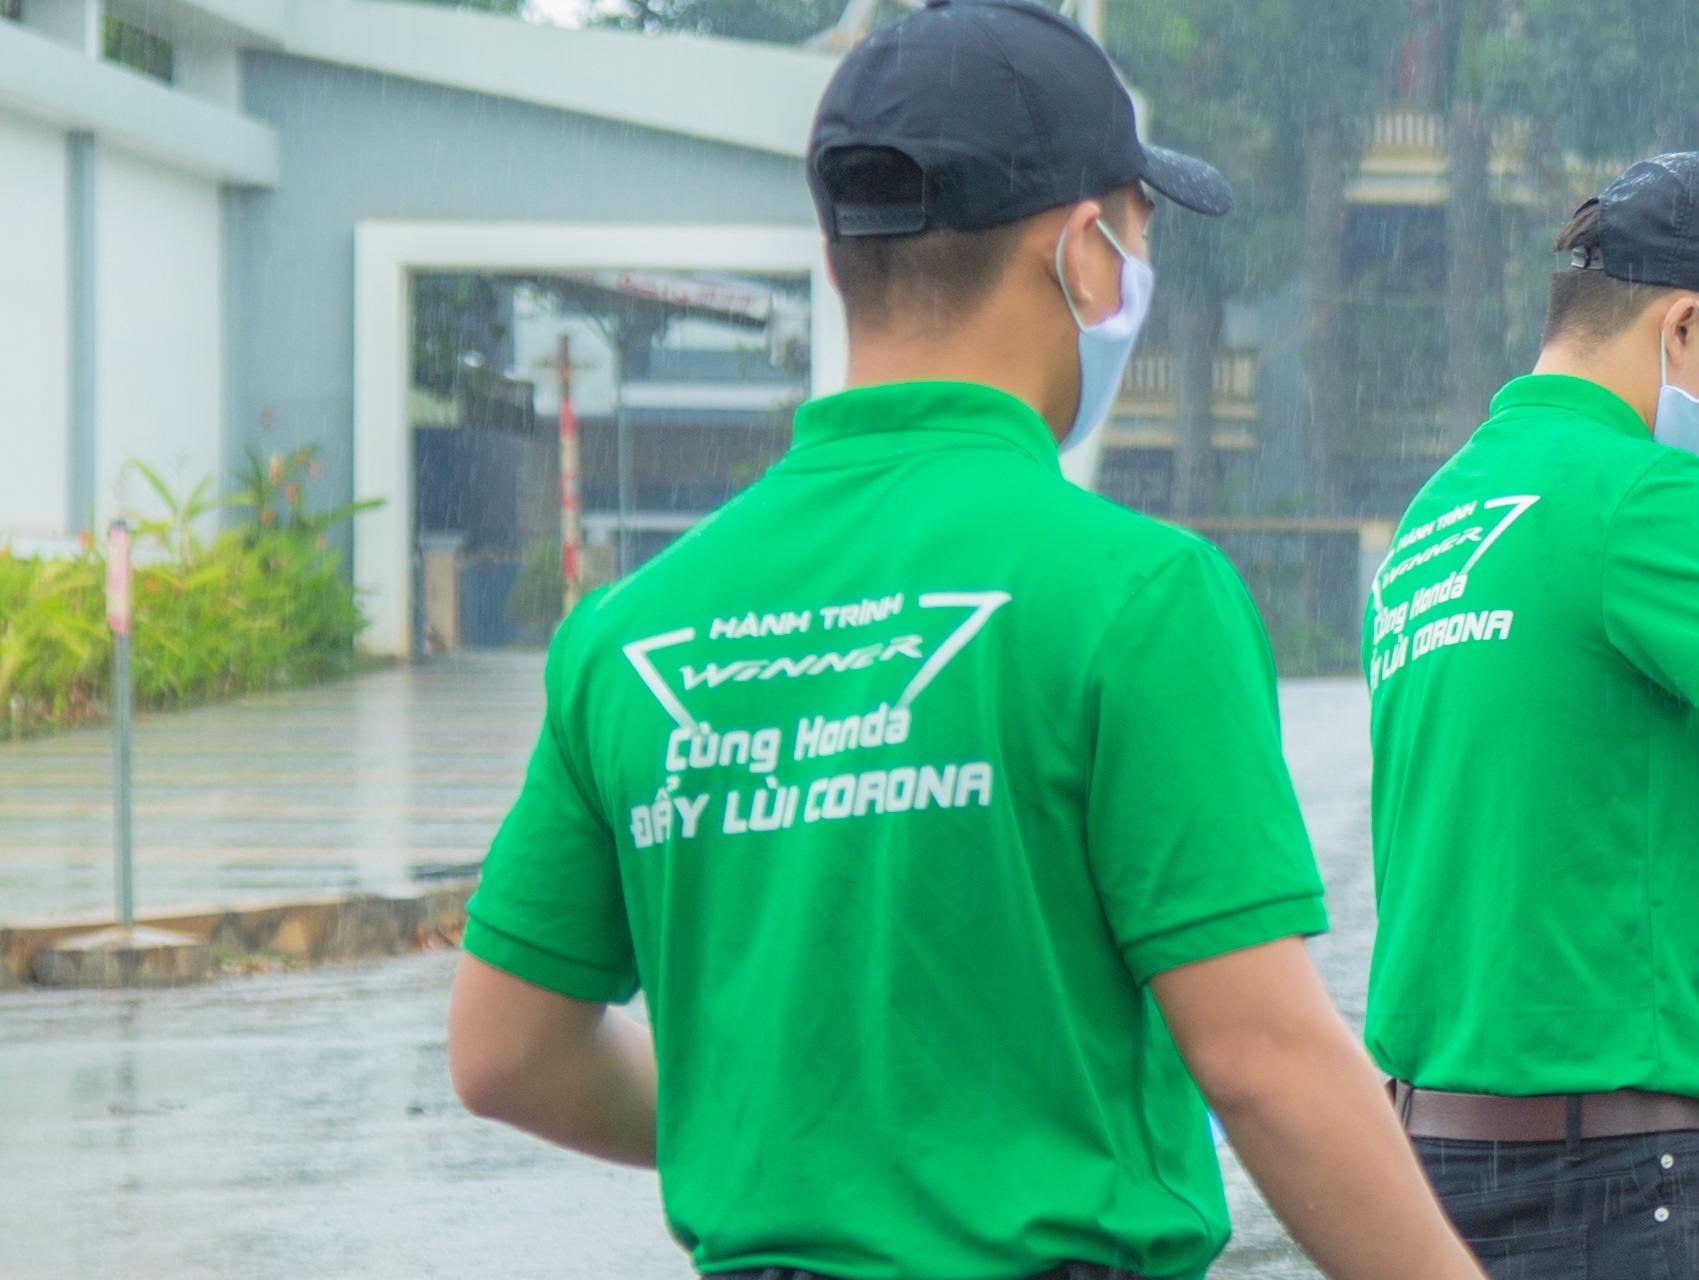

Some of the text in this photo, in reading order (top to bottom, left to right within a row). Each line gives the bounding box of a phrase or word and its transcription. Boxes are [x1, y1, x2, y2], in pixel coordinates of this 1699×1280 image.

[709, 592, 904, 639] HÀNH TRÌNH
[1409, 571, 1469, 620] Honda
[1411, 609, 1514, 661] CORONA
[680, 634, 924, 691] WINNER
[665, 702, 911, 773] Cùng Honda
[630, 761, 994, 849] ĐẨY LÙI CORONA
